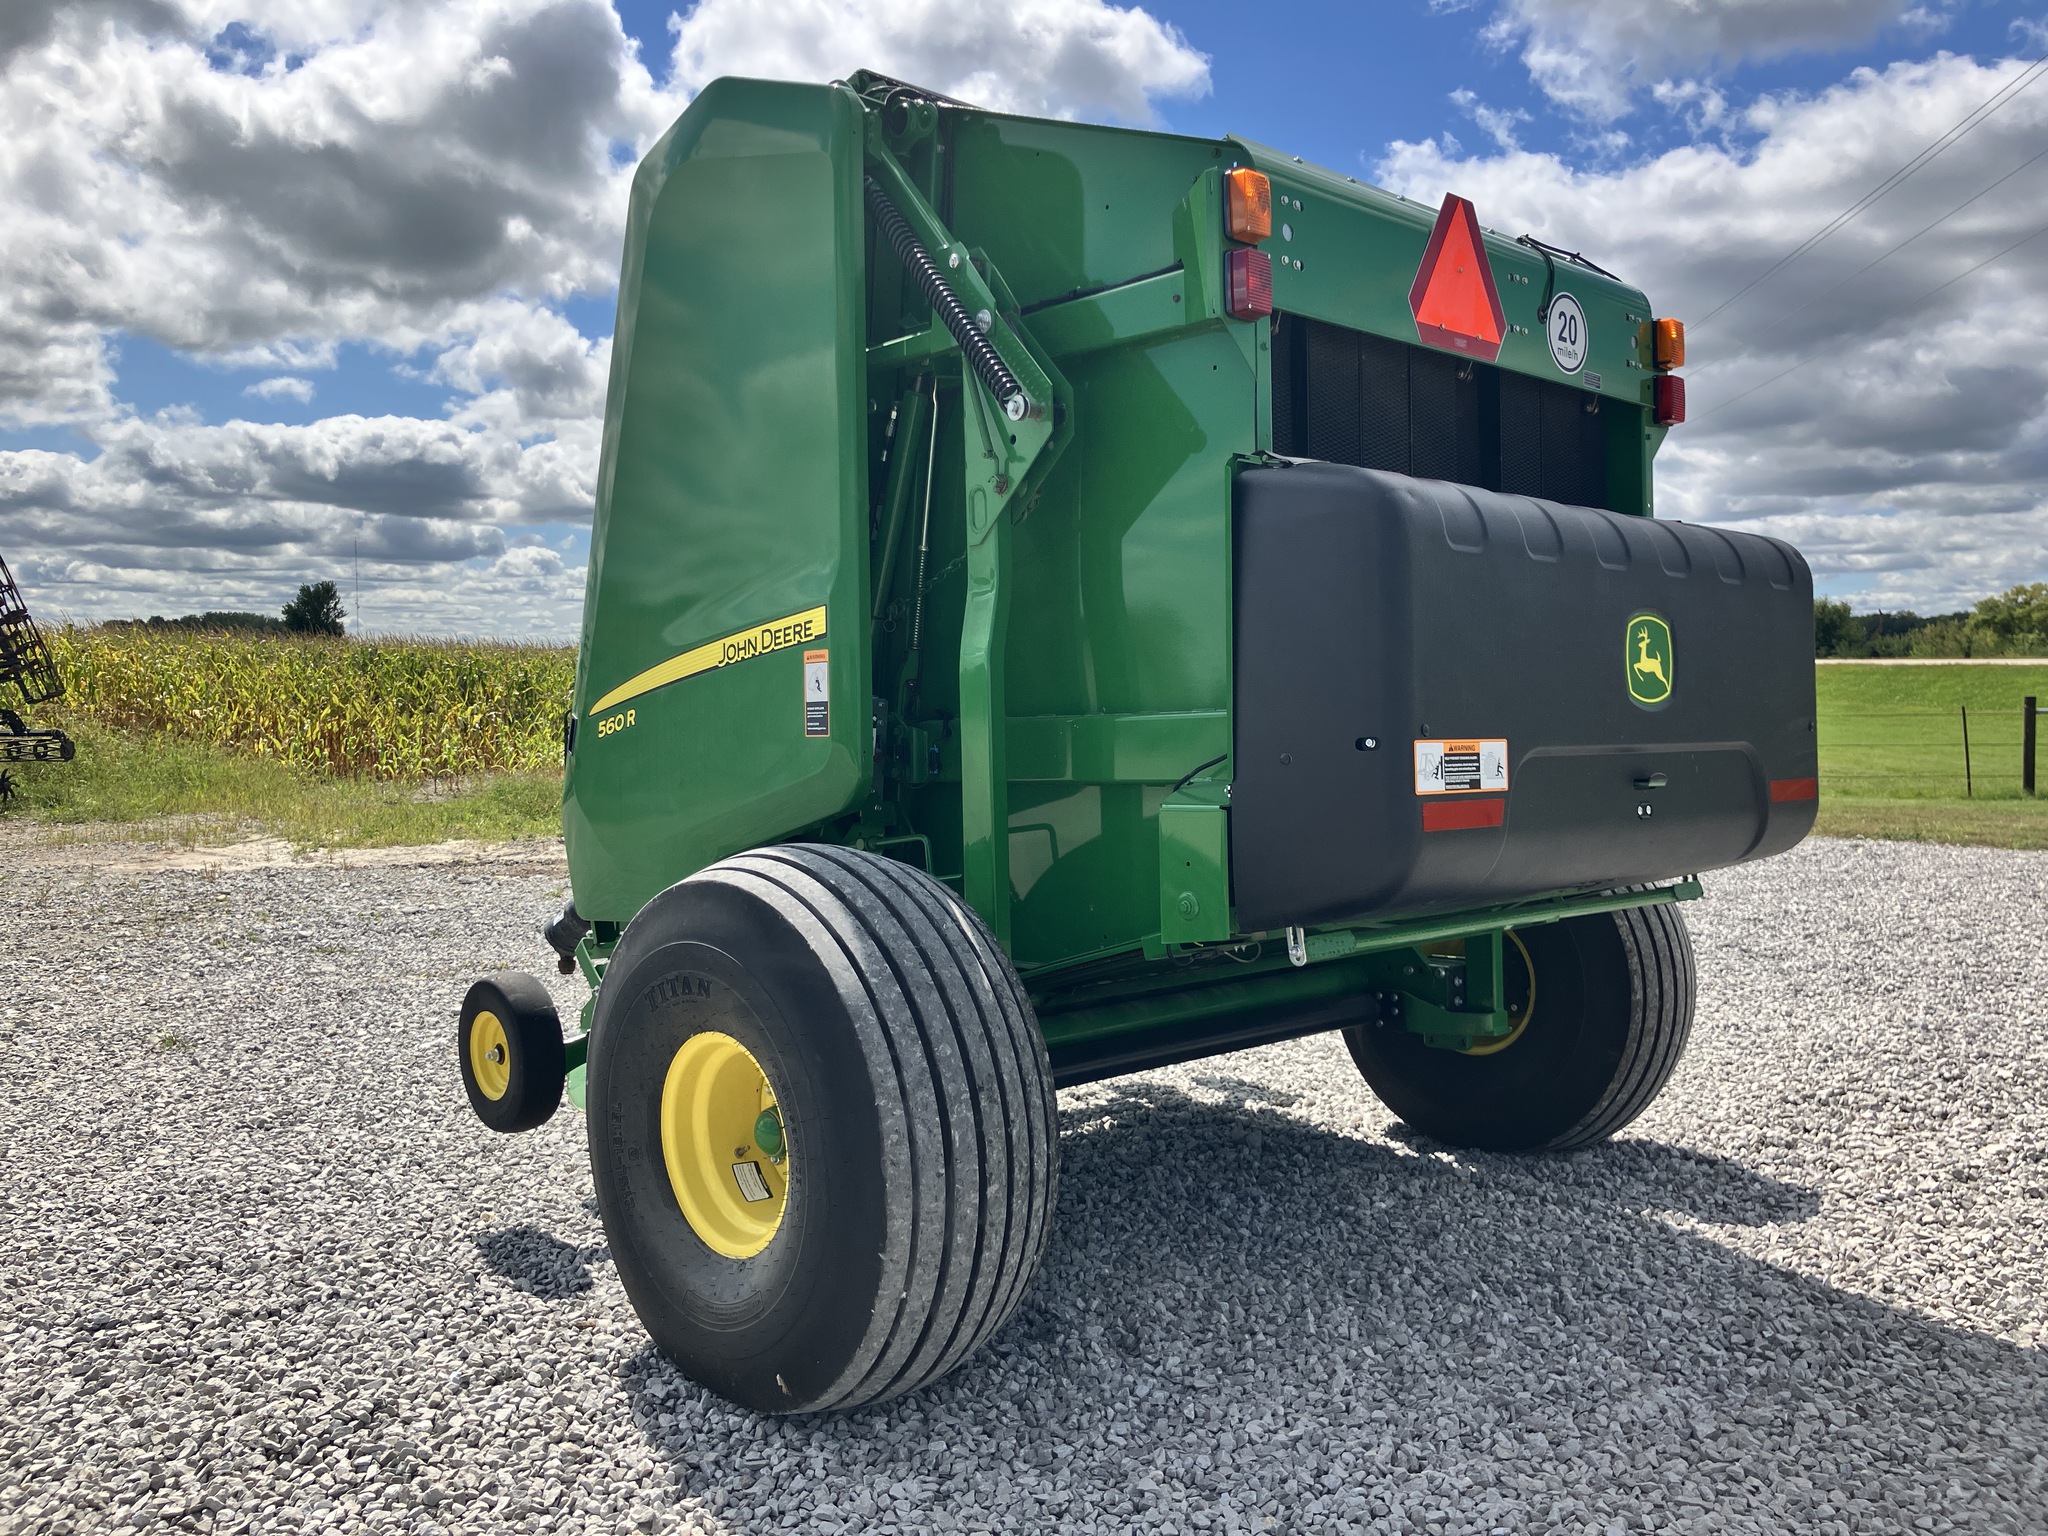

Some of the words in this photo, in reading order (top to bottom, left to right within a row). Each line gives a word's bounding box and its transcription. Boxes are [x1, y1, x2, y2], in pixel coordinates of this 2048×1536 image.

[1557, 310, 1578, 346] 20
[1557, 346, 1579, 361] mile/h
[718, 638, 758, 666] JOHN
[761, 619, 813, 651] DEERE
[598, 713, 625, 739] 560
[627, 709, 636, 728] R
[1453, 744, 1476, 752] WARNING
[642, 975, 713, 1013] TITAN
